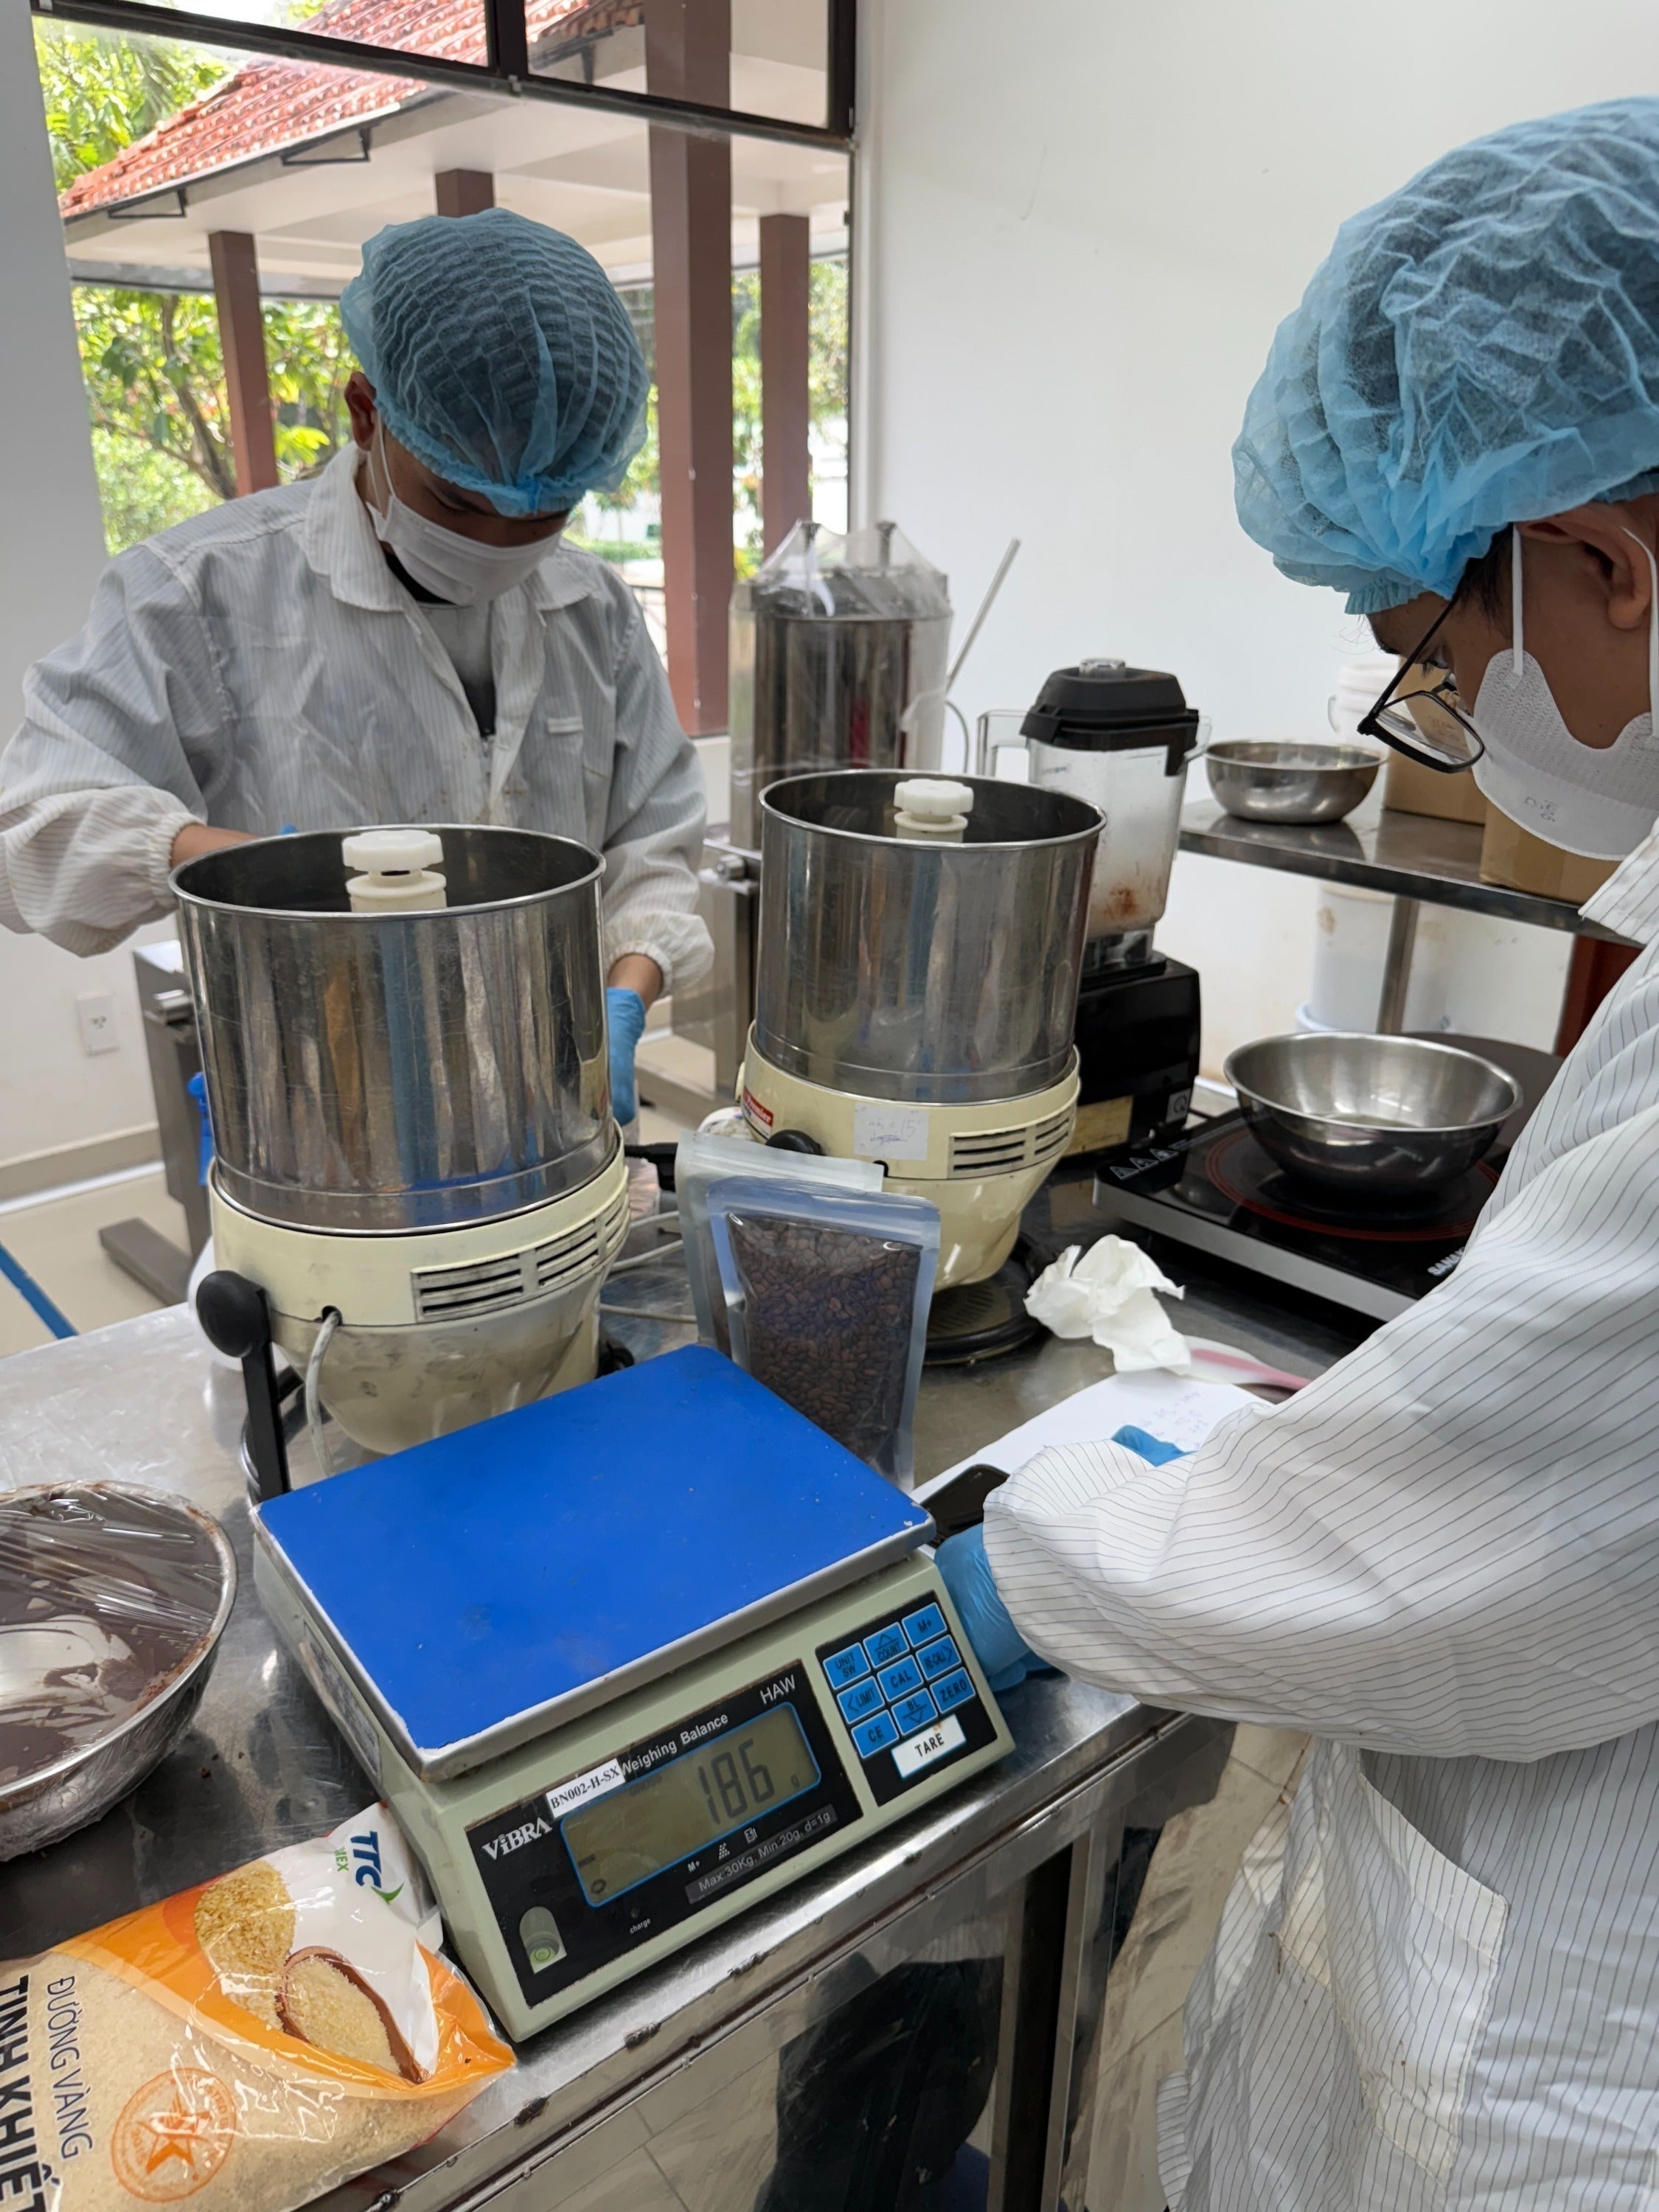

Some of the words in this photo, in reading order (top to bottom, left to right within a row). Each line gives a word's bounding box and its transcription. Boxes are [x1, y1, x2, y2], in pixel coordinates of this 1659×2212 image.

[836, 1652, 854, 1669] UNIT
[877, 1641, 902, 1660] COUNT
[842, 1663, 857, 1677] SW
[890, 1669, 913, 1688] CAL
[760, 1674, 796, 1704] HAW
[939, 1680, 967, 1702] ZERO
[907, 1697, 920, 1711] BL
[620, 1740, 677, 1775] Weighing
[680, 1714, 728, 1745] Balance
[868, 1726, 884, 1742] CE
[914, 1733, 945, 1757] TARE
[550, 1765, 621, 1809] BN002-H-SX
[698, 1739, 775, 1824] 186
[350, 1830, 382, 1888] TTC
[688, 1860, 700, 1873] M+
[629, 1917, 651, 1935] charge
[0, 1974, 29, 2069] TINH
[47, 1975, 83, 2070] ĐƯỜNG
[53, 2067, 93, 2160] VÀNG
